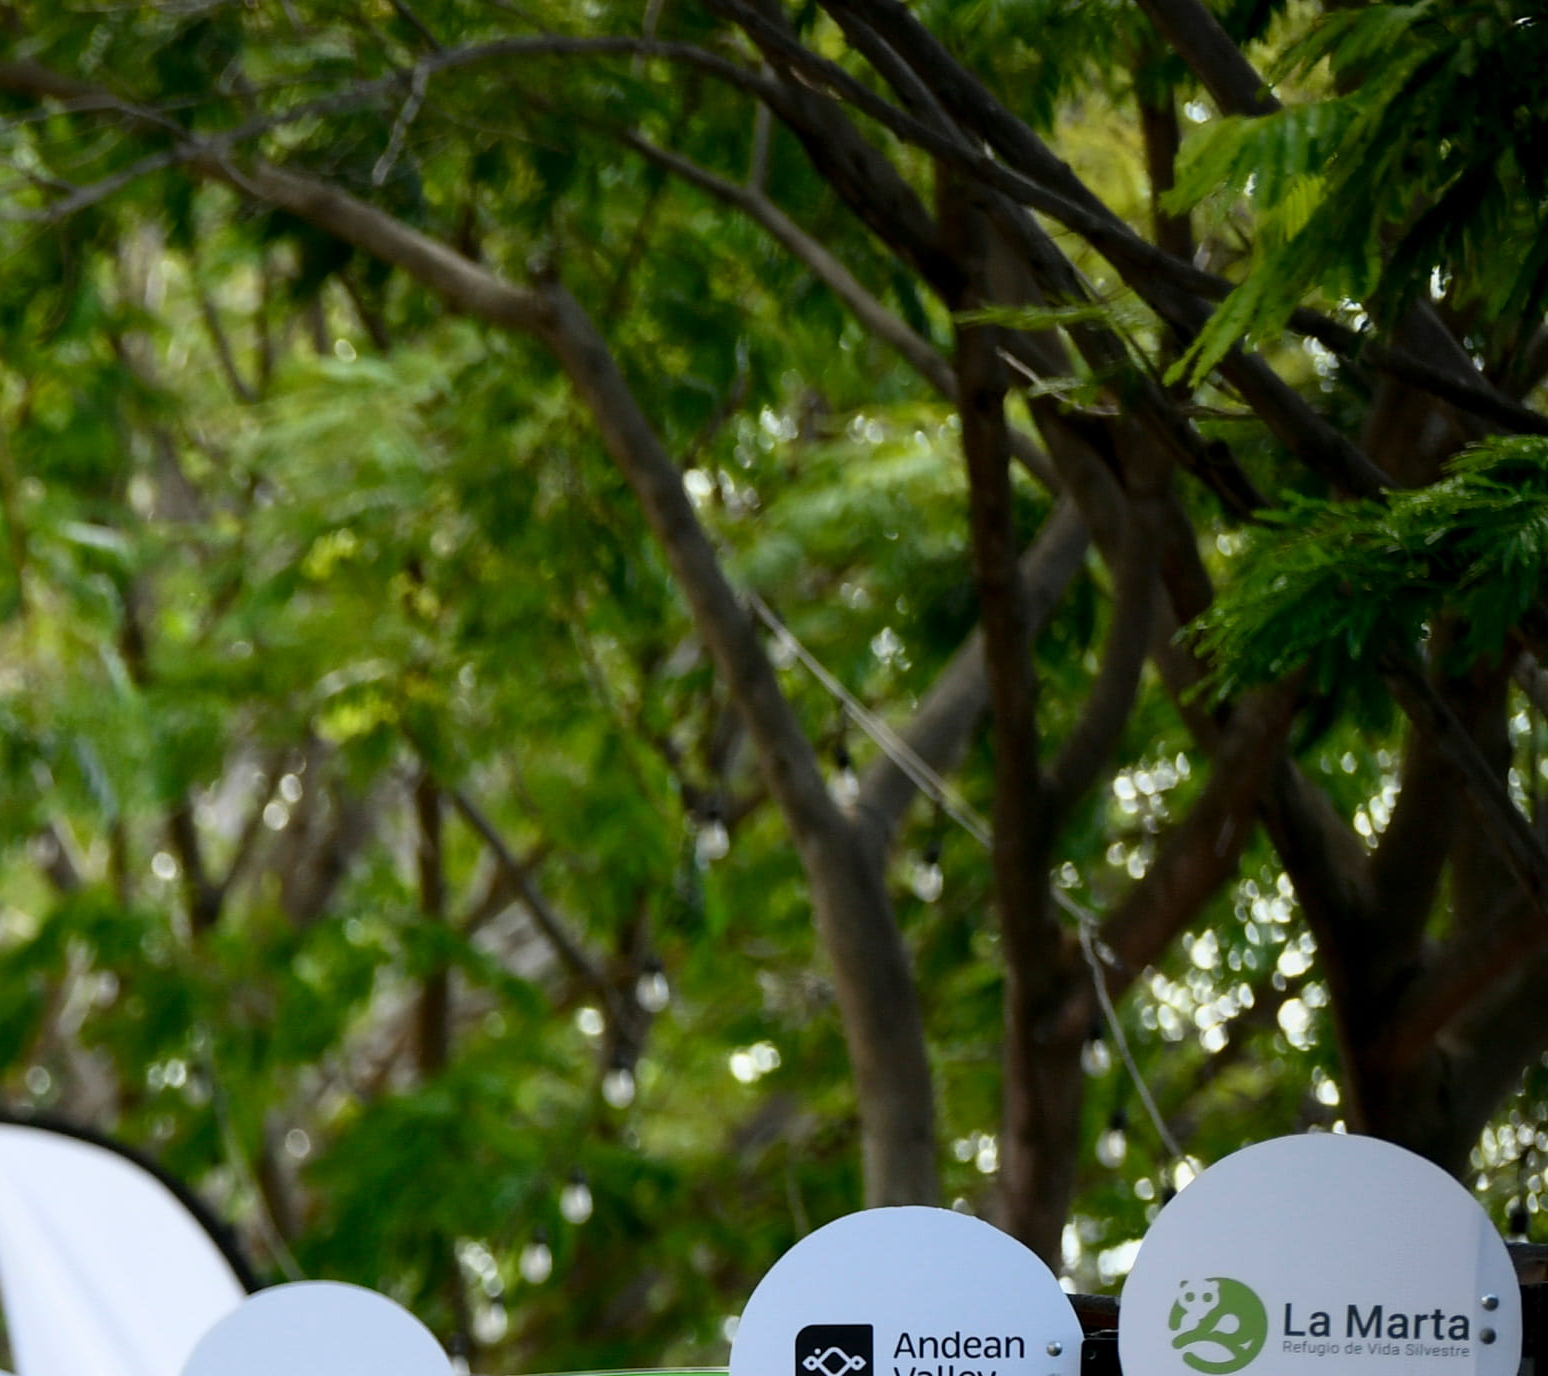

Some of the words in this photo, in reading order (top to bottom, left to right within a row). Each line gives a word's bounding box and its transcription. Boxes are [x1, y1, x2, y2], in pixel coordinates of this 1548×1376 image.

[1283, 1302, 1331, 1338] La
[1345, 1304, 1470, 1341] Marta
[892, 1331, 1025, 1359] Andean
[1281, 1340, 1341, 1358] Refugio
[1343, 1342, 1363, 1355] de
[1367, 1342, 1401, 1356] Vida
[1404, 1343, 1471, 1358] Silvestre
